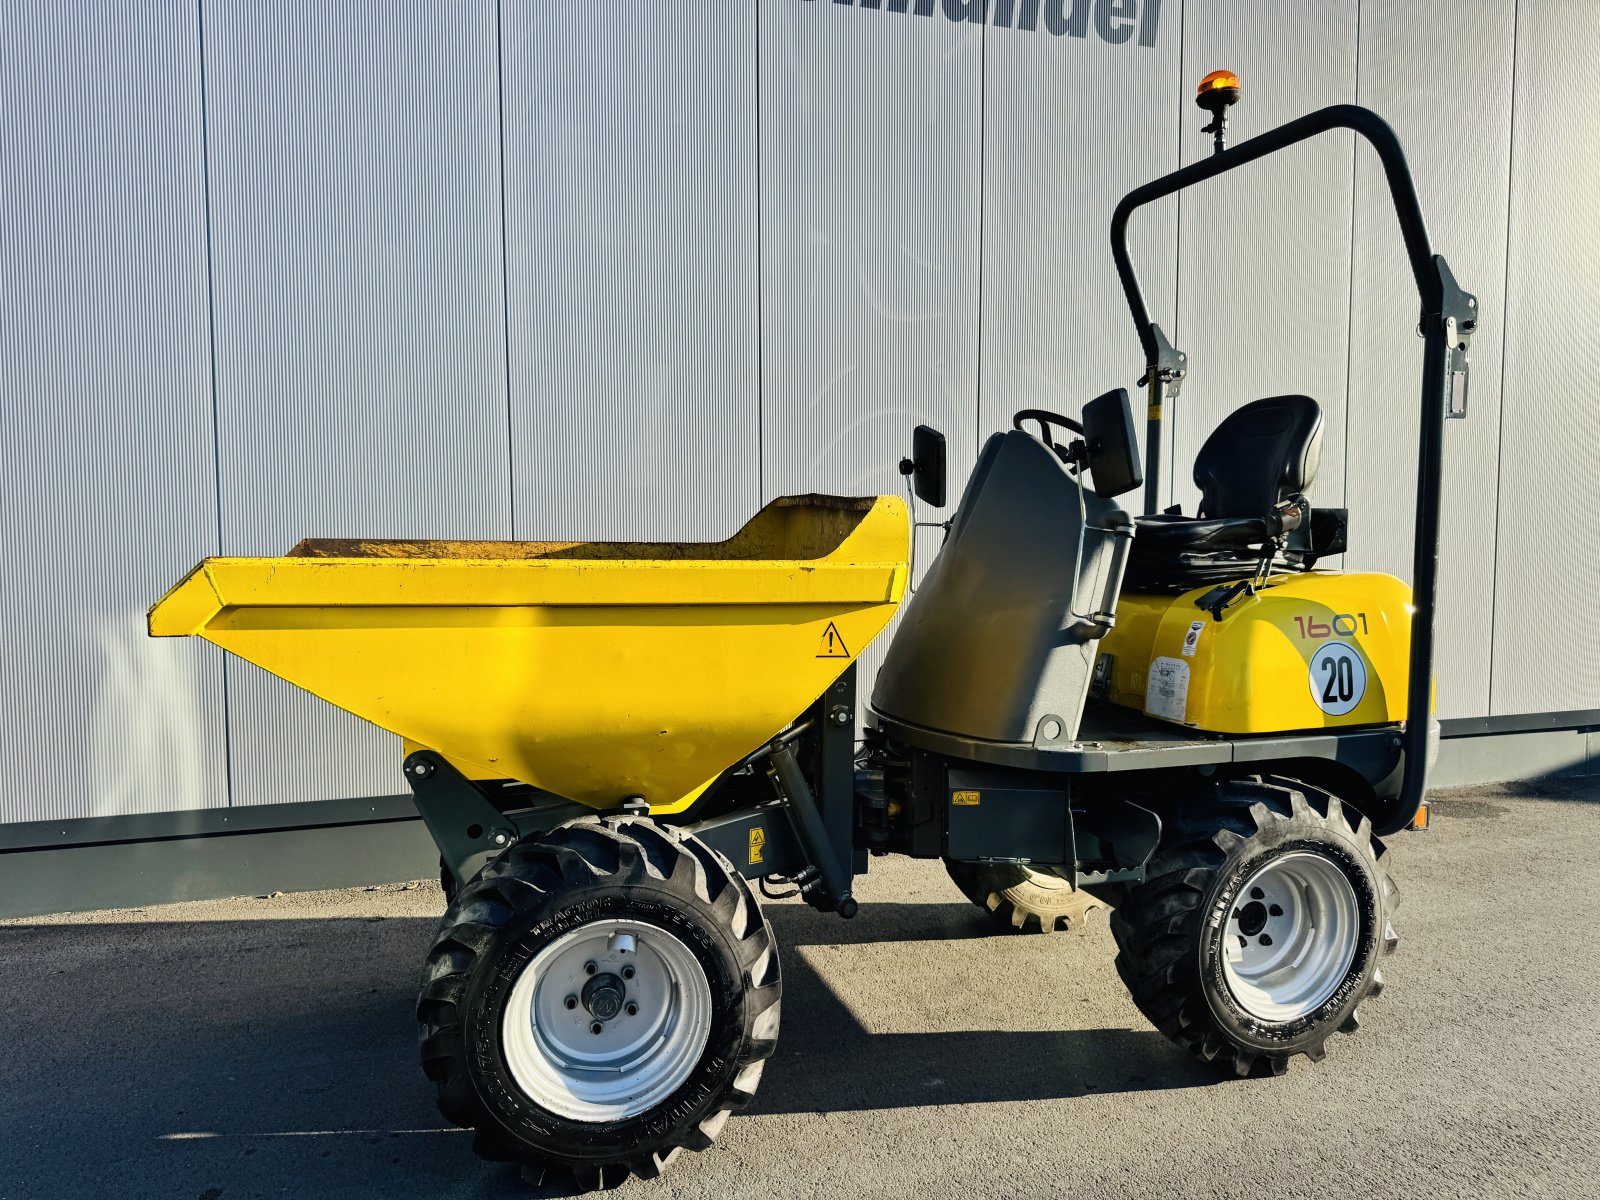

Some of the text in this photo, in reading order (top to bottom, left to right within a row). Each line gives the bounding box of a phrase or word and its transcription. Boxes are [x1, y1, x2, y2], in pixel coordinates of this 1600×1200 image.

[1294, 613, 1368, 639] 1601
[1321, 656, 1353, 703] 20
[529, 896, 611, 937] TRACTOR
[1209, 861, 1250, 928] MITAS
